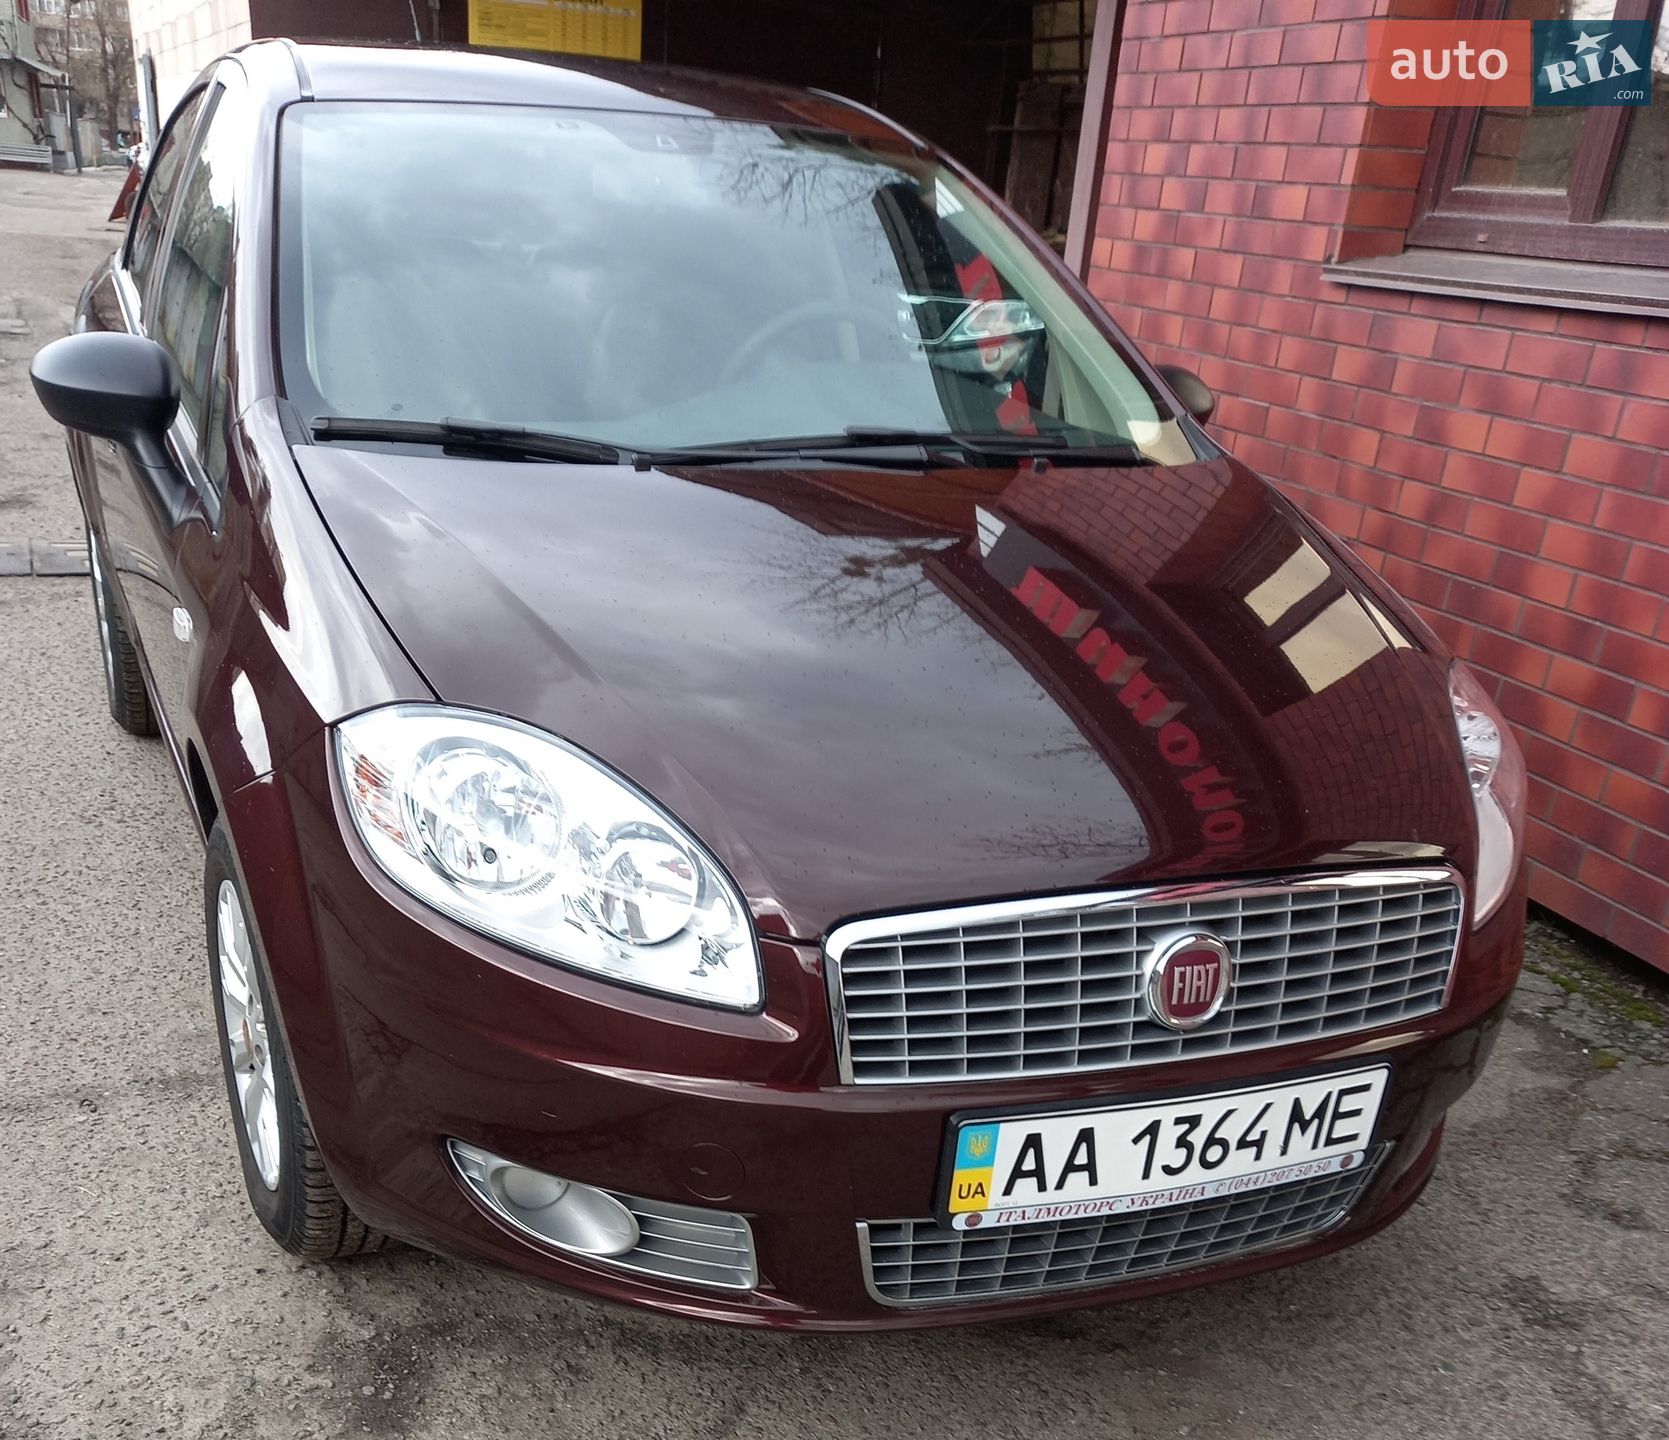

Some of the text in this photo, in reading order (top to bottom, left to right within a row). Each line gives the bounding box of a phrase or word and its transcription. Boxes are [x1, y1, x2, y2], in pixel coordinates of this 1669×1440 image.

[1171, 963, 1218, 1005] FIAT
[1001, 1083, 1373, 1197] AA 1364 ME
[957, 1182, 986, 1200] UA
